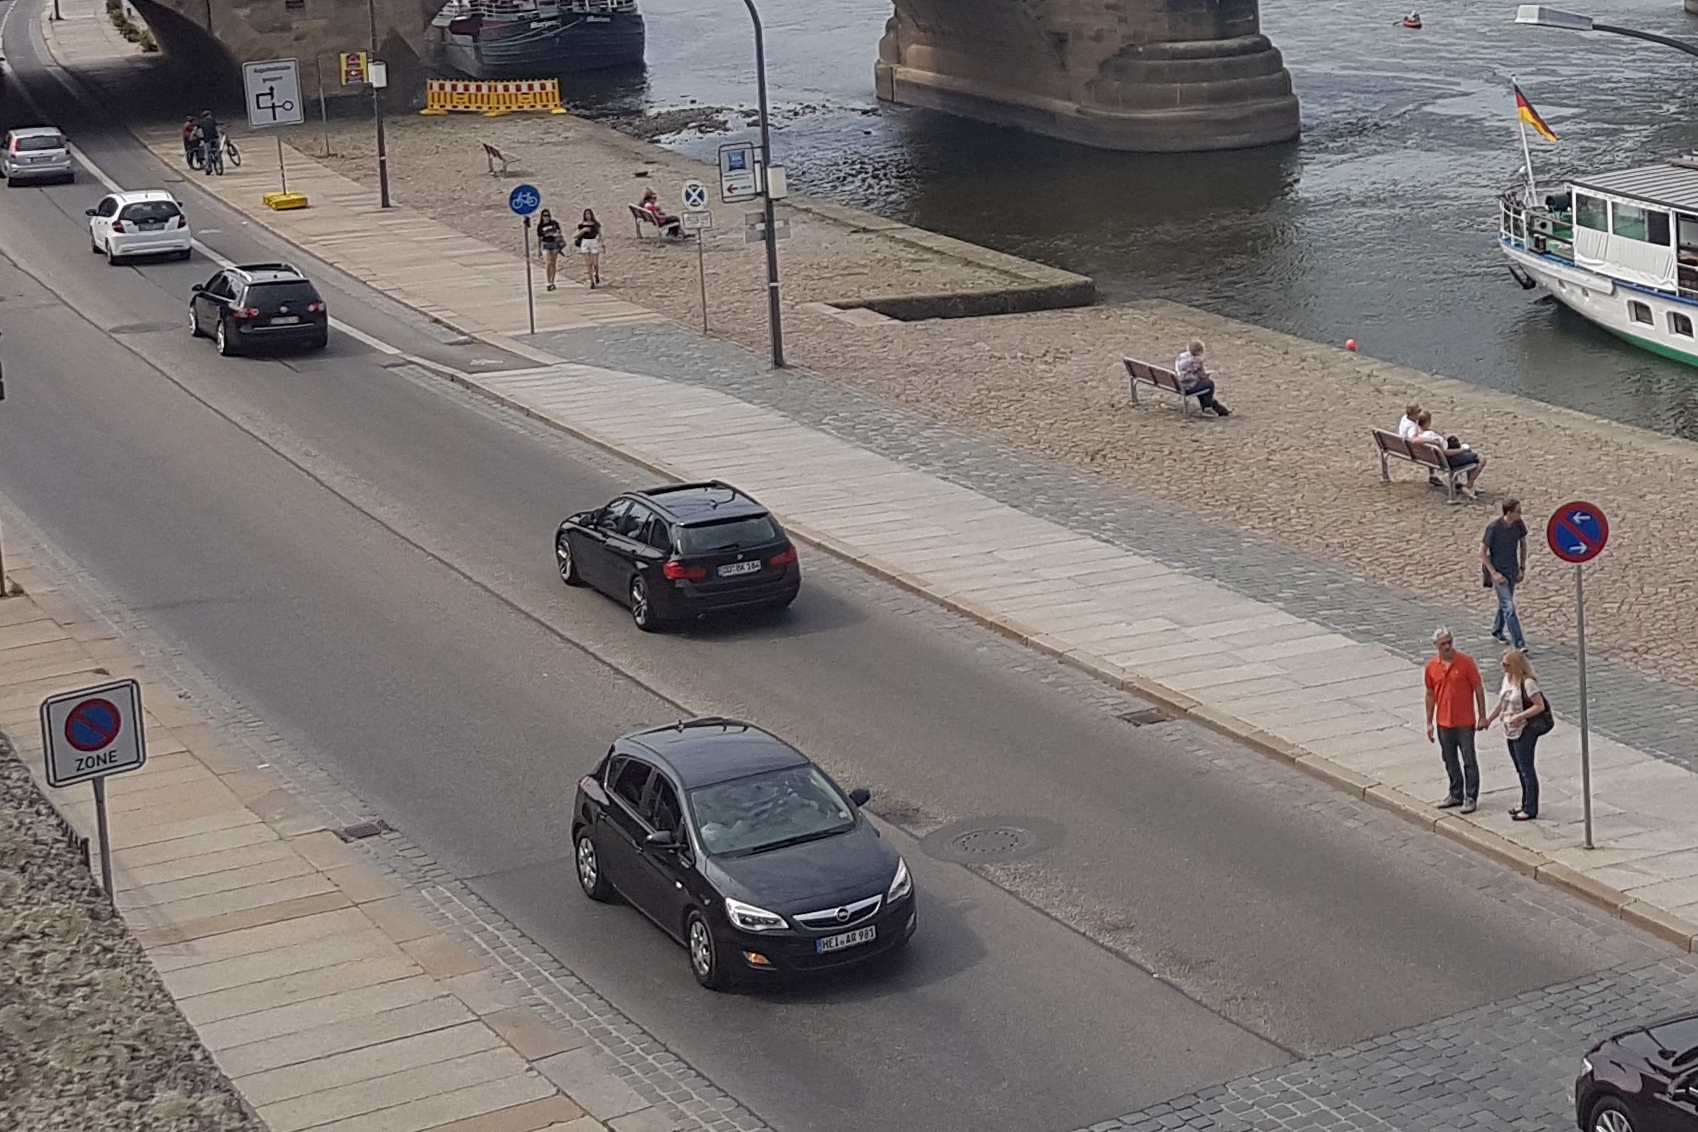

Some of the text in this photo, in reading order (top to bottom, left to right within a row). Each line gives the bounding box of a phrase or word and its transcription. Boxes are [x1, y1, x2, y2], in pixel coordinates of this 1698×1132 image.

[75, 749, 118, 772] ZONE
[822, 936, 839, 949] HEI
[846, 933, 857, 944] AR
